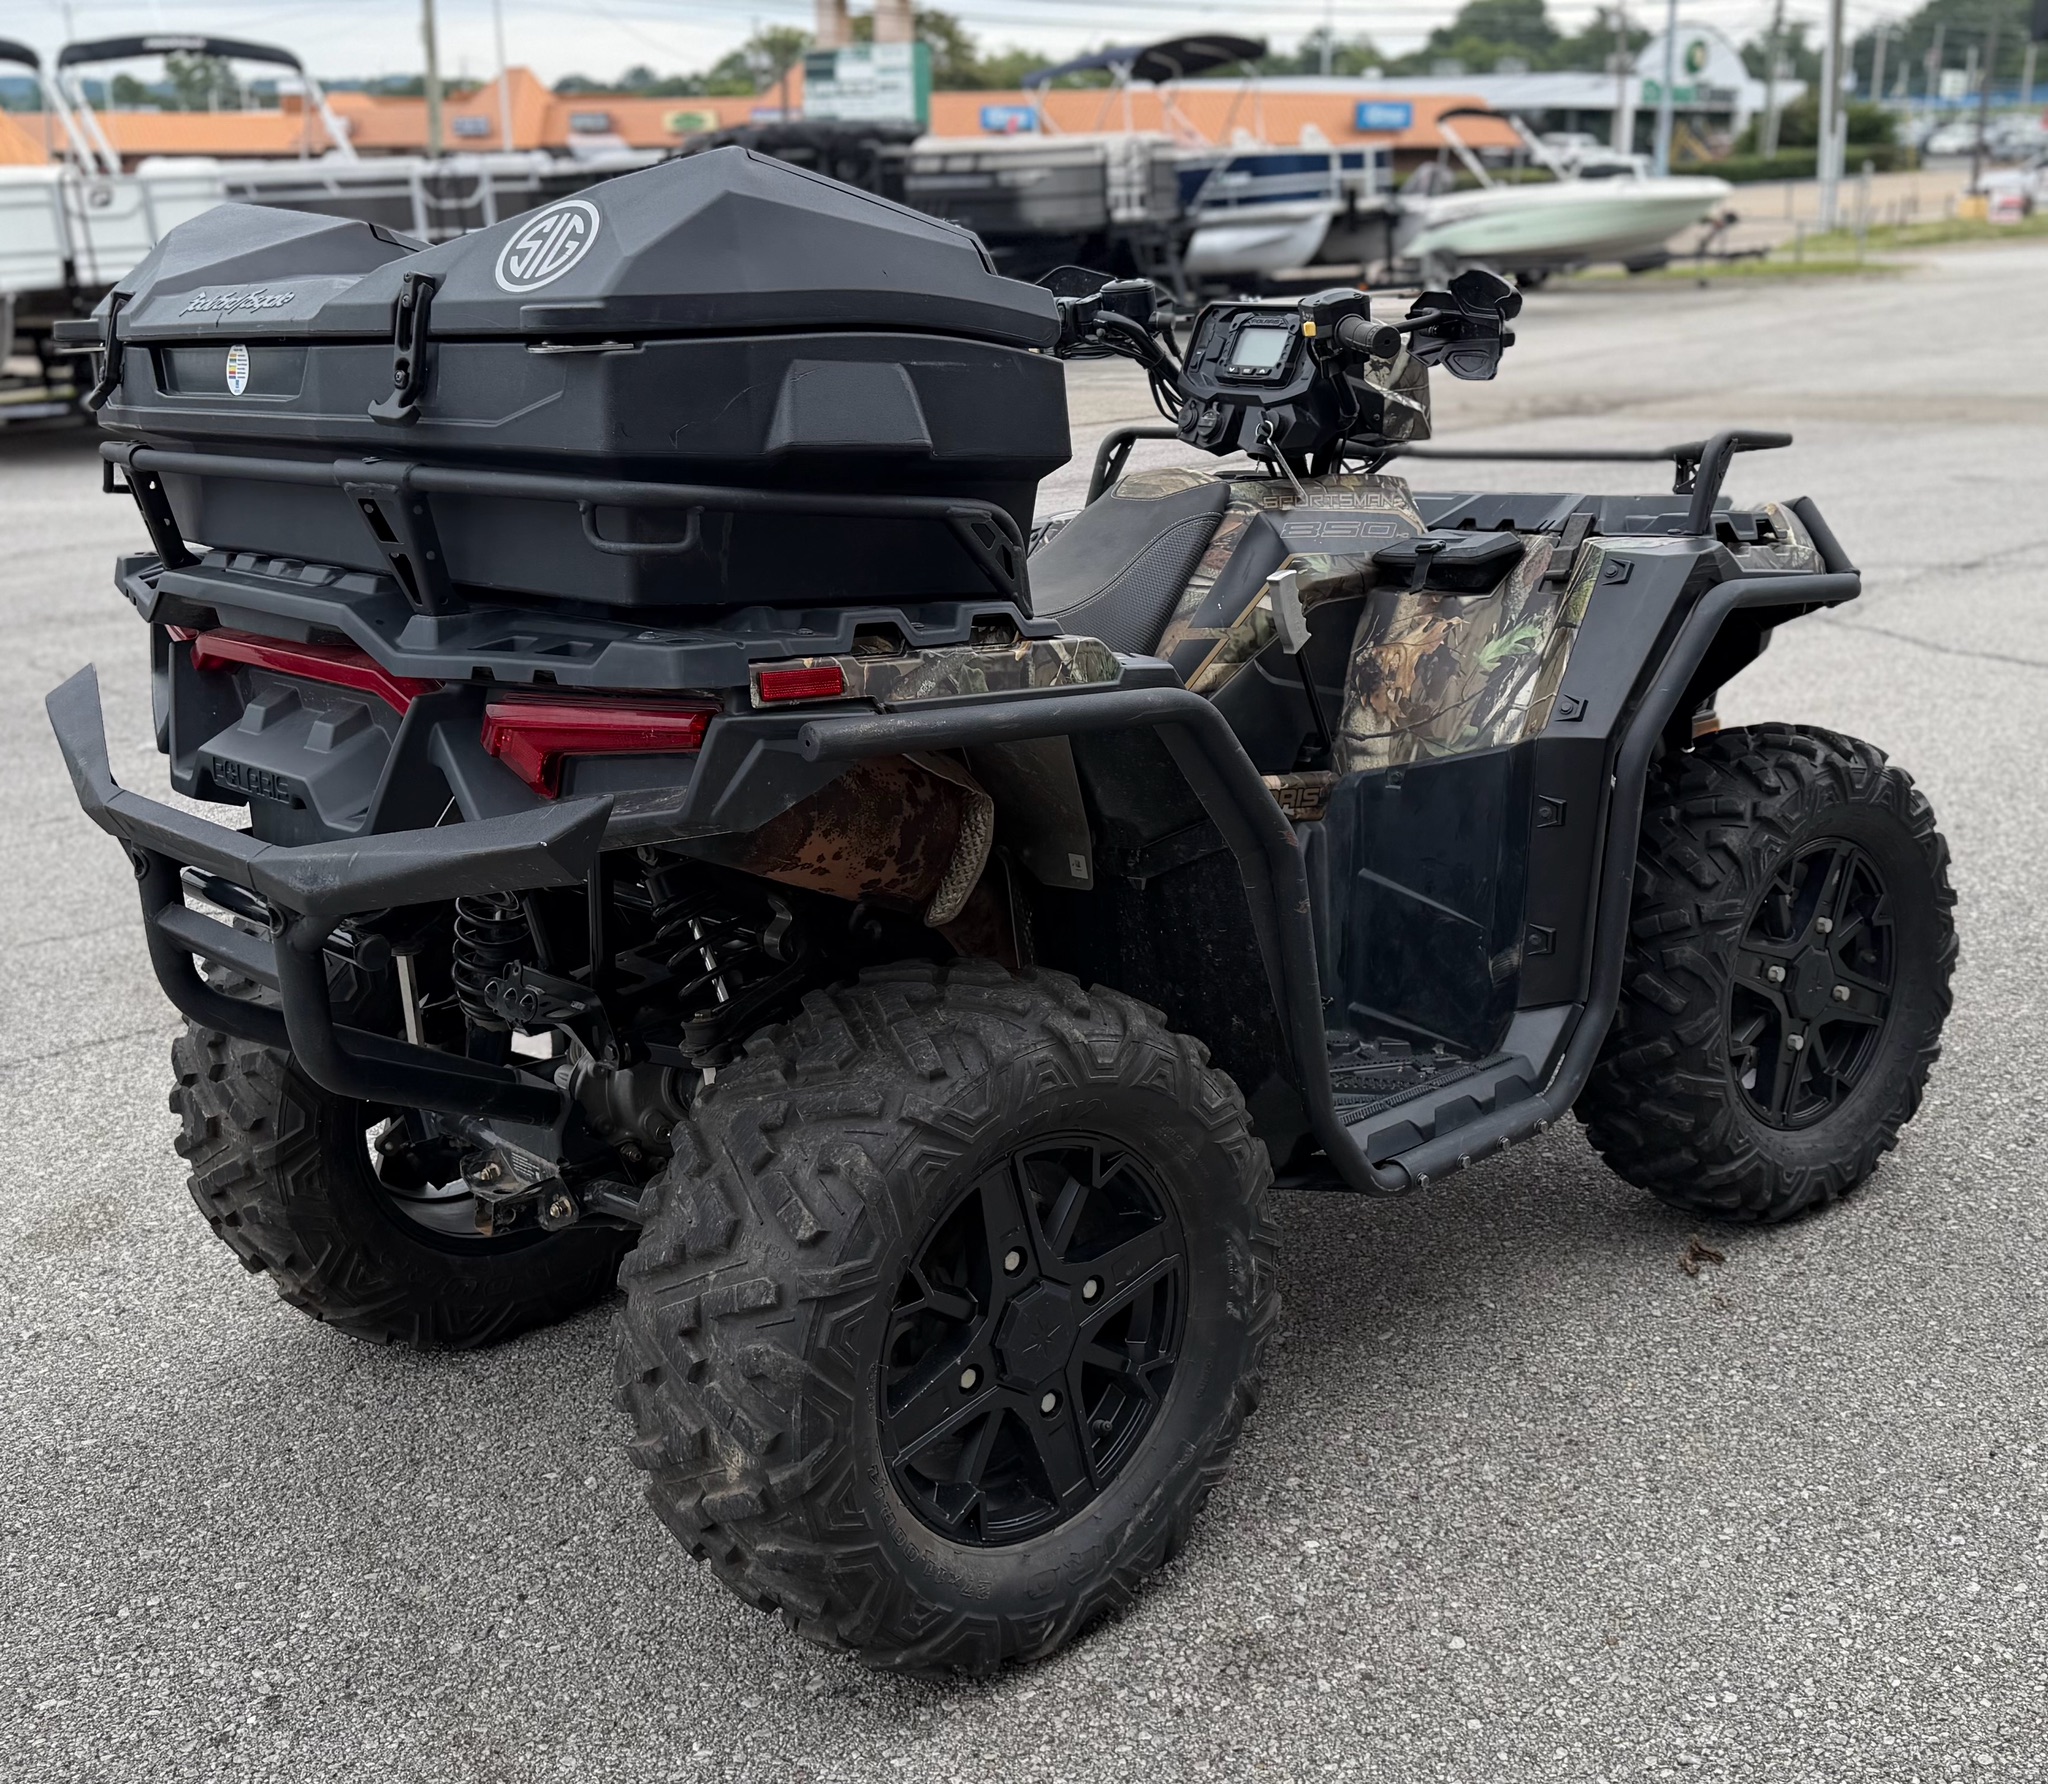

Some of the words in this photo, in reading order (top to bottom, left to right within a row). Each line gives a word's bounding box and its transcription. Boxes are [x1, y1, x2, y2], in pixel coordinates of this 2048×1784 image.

[509, 212, 585, 279] SIG
[1263, 493, 1395, 509] SPORTSMAN
[1280, 521, 1398, 538] 850
[212, 756, 290, 804] POLARIS
